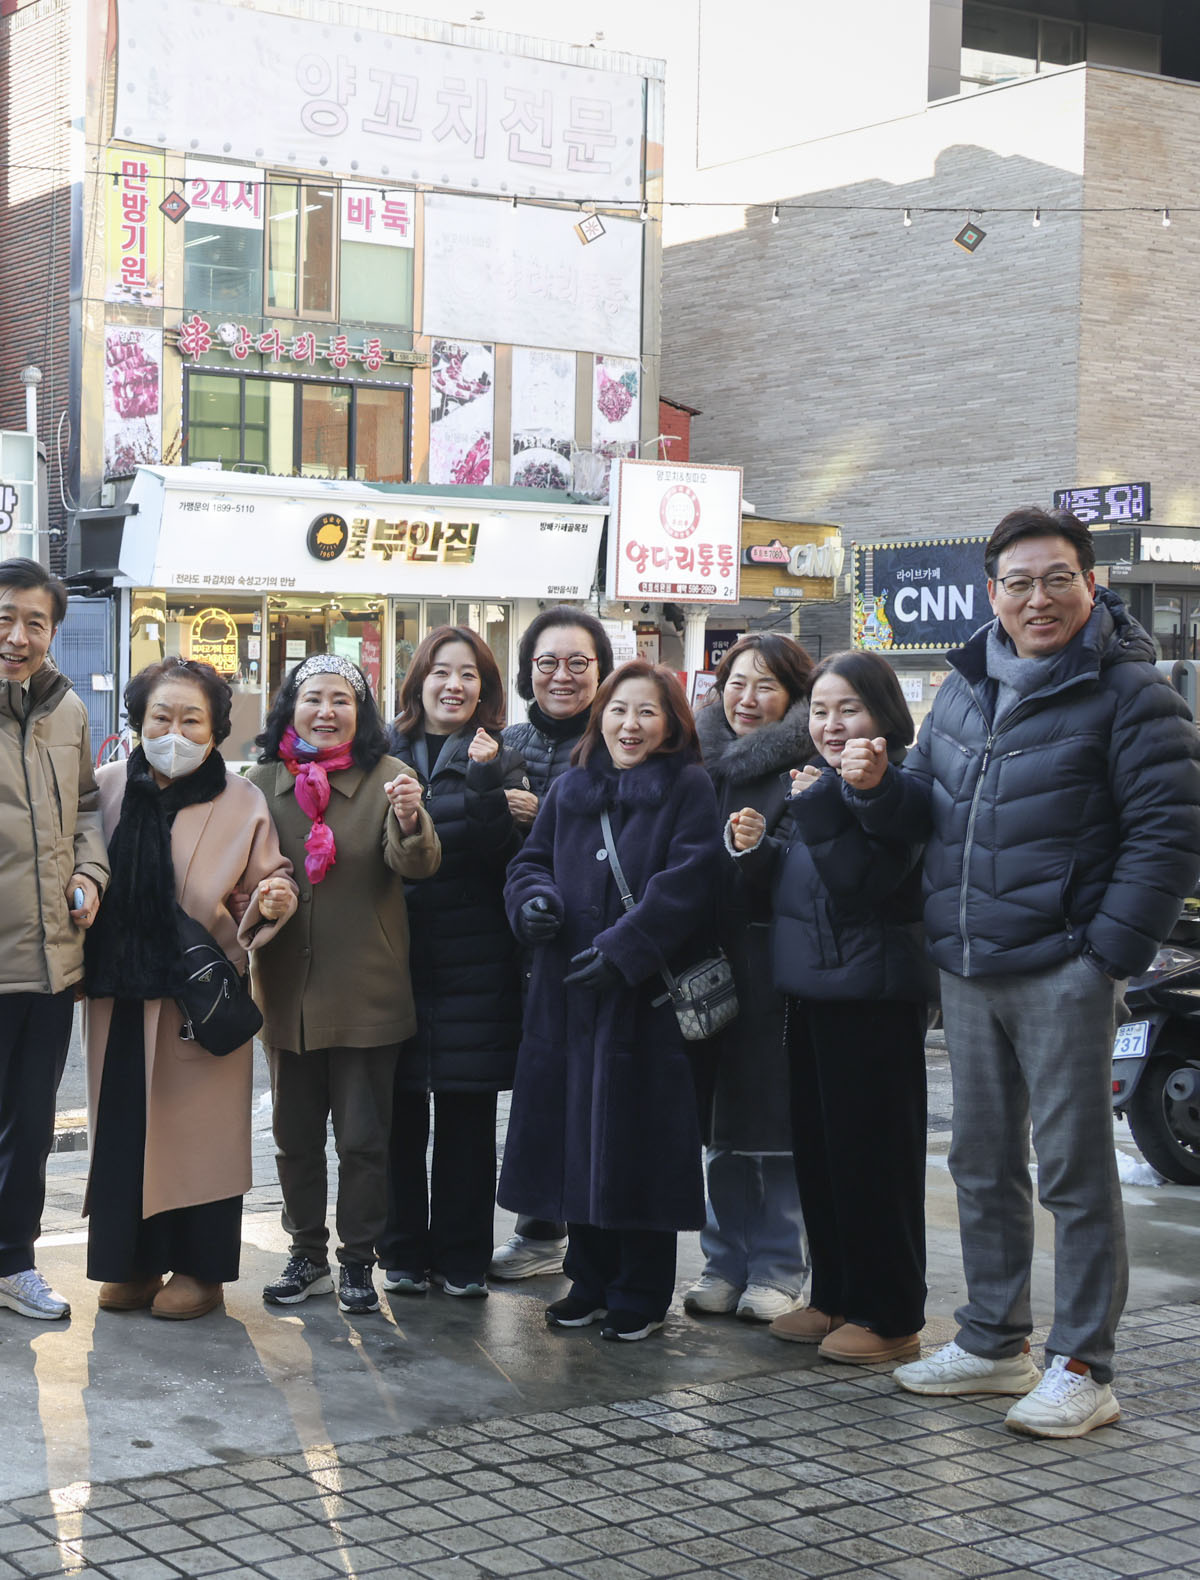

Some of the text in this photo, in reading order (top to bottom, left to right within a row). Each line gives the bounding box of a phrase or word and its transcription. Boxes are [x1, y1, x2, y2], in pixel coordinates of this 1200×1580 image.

[296, 53, 617, 175] 양꼬치전문
[121, 160, 149, 287] 만방기원
[191, 177, 410, 236] 24시 바둑
[178, 501, 255, 513] 가맹문의 1899-5110
[319, 550, 336, 558] 1960
[371, 517, 480, 563] 부안집
[625, 540, 735, 578] 양다리통통
[788, 543, 846, 577] CNN
[896, 567, 941, 581] 라이브카페
[175, 573, 296, 588] 전라도 파김치와 숙성고기의 만남
[547, 584, 579, 595] 일반음식점
[894, 584, 975, 622] CNN
